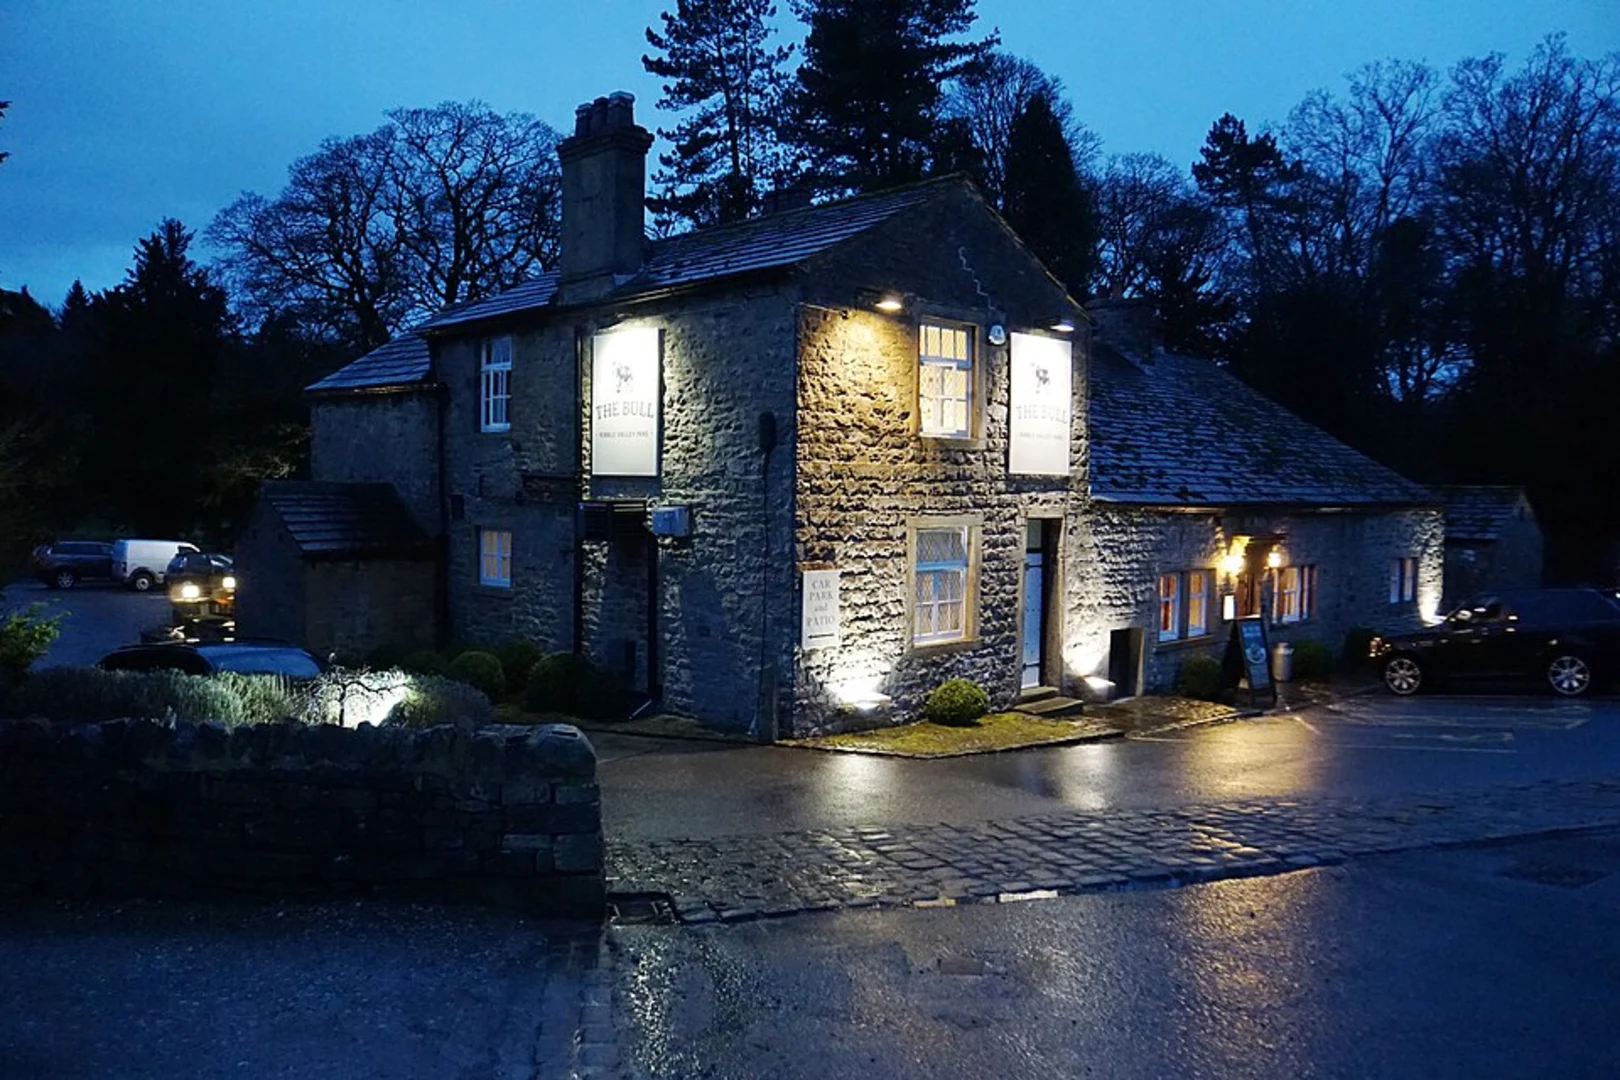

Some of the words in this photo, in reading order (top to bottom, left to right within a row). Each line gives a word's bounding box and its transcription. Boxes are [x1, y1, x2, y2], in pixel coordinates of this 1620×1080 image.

[596, 400, 620, 420] THE
[622, 400, 654, 419] BULL
[1016, 404, 1039, 420] THE
[1041, 404, 1068, 425] BULL
[811, 580, 831, 589] CAR
[809, 592, 834, 601] PARK
[814, 602, 828, 612] and
[807, 615, 835, 626] PATIO
